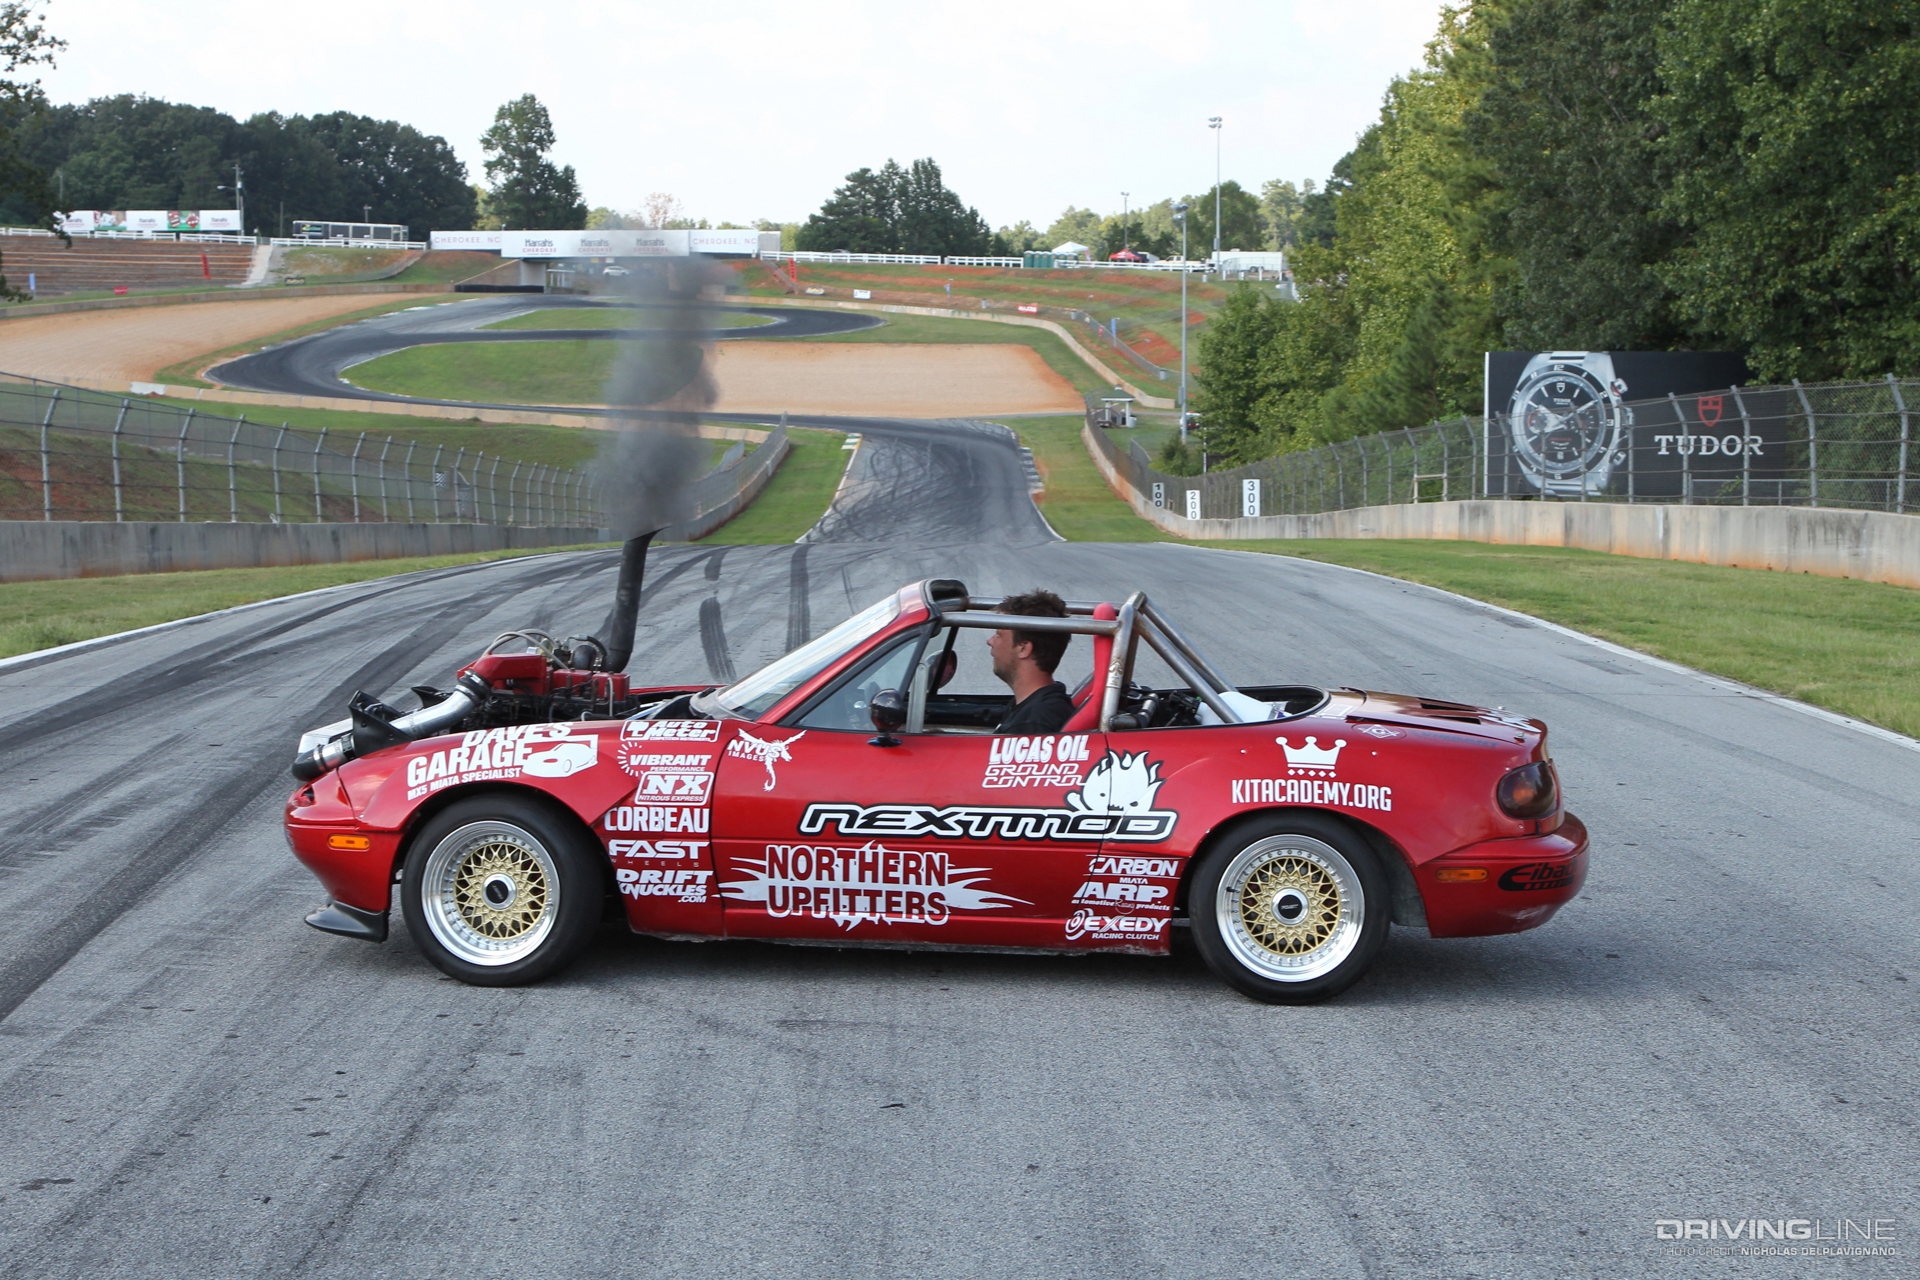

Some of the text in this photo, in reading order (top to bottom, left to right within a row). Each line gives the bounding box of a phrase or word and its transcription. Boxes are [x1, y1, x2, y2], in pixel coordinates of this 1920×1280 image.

[487, 236, 501, 244] NC
[1654, 435, 1764, 456] TUDOR
[1154, 484, 1162, 508] 100
[1248, 480, 1256, 516] 300
[462, 722, 574, 748] DAVE'S
[728, 750, 766, 762] IMAGES
[988, 734, 1090, 764] LUCAS OIL
[407, 738, 533, 788] GARAGE
[630, 754, 712, 766] VIBRANT
[985, 763, 1080, 776] GROUND
[407, 767, 523, 801] MX5 MIATA SPECIALIST
[642, 775, 710, 795] NX
[982, 774, 1086, 788] CONTROL
[1232, 779, 1392, 812] KITACADEMY.ORG
[604, 806, 710, 833] CORBEAU
[608, 840, 711, 860] FAST
[616, 868, 714, 884] DRIFT
[766, 846, 950, 887] NORTHERN
[1088, 858, 1179, 876] CARBON
[618, 882, 708, 900] KNUCKLES
[1073, 882, 1168, 902] ARP
[766, 884, 950, 925] UPFITTERS
[1084, 916, 1172, 932] EXEDY
[1092, 932, 1124, 940] RACING
